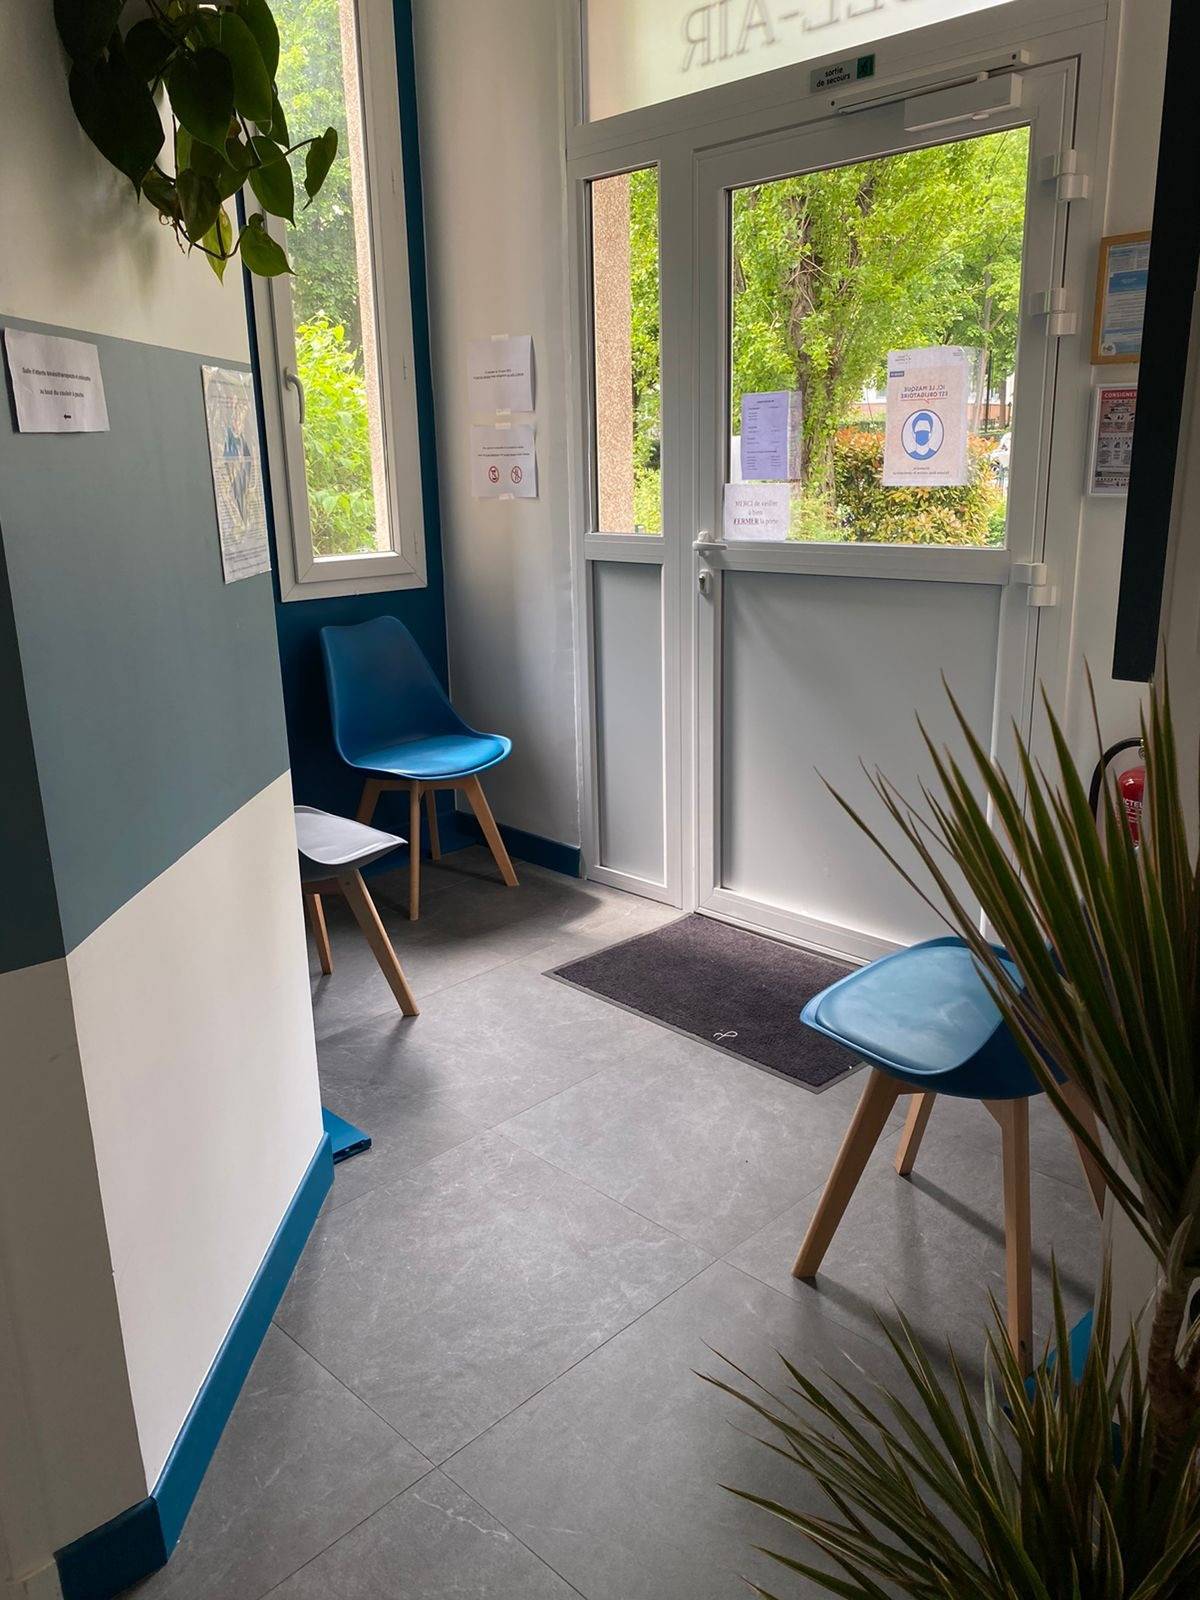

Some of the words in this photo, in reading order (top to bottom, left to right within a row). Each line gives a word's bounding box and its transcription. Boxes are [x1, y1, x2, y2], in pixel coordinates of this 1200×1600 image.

[824, 66, 843, 77] sortie
[816, 79, 825, 87] de
[826, 73, 850, 85] secours
